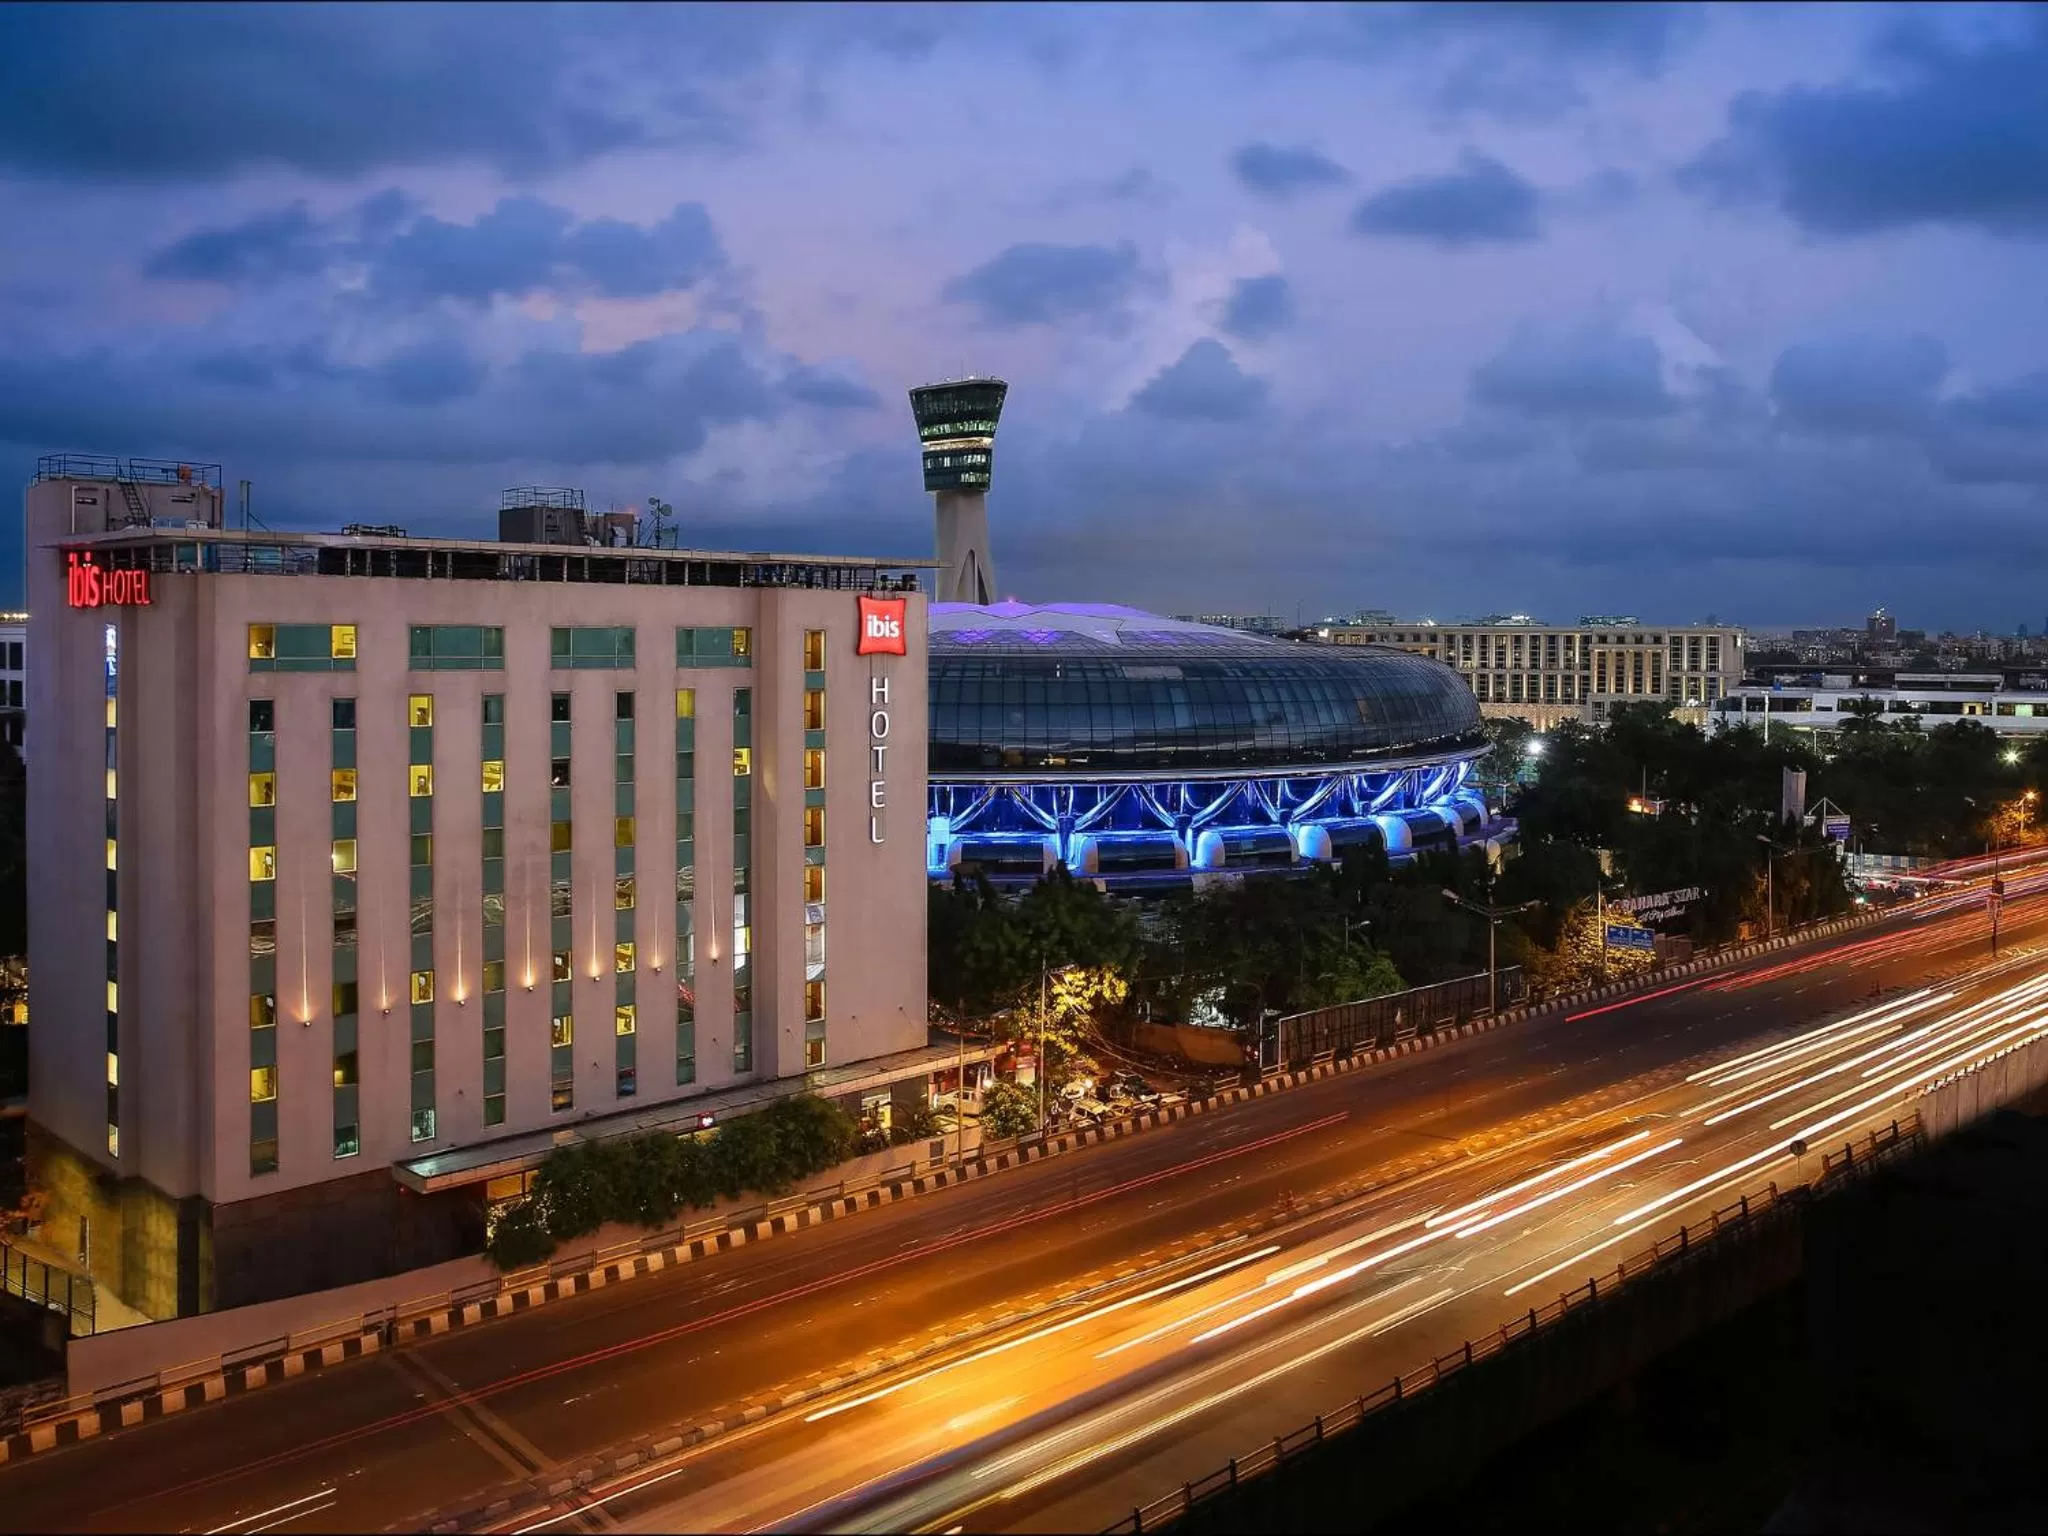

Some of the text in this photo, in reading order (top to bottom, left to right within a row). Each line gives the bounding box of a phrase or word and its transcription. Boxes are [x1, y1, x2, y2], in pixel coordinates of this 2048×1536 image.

[68, 551, 151, 607] ibis HOTEL
[866, 614, 900, 638] ibis
[871, 677, 890, 843] HOTEL
